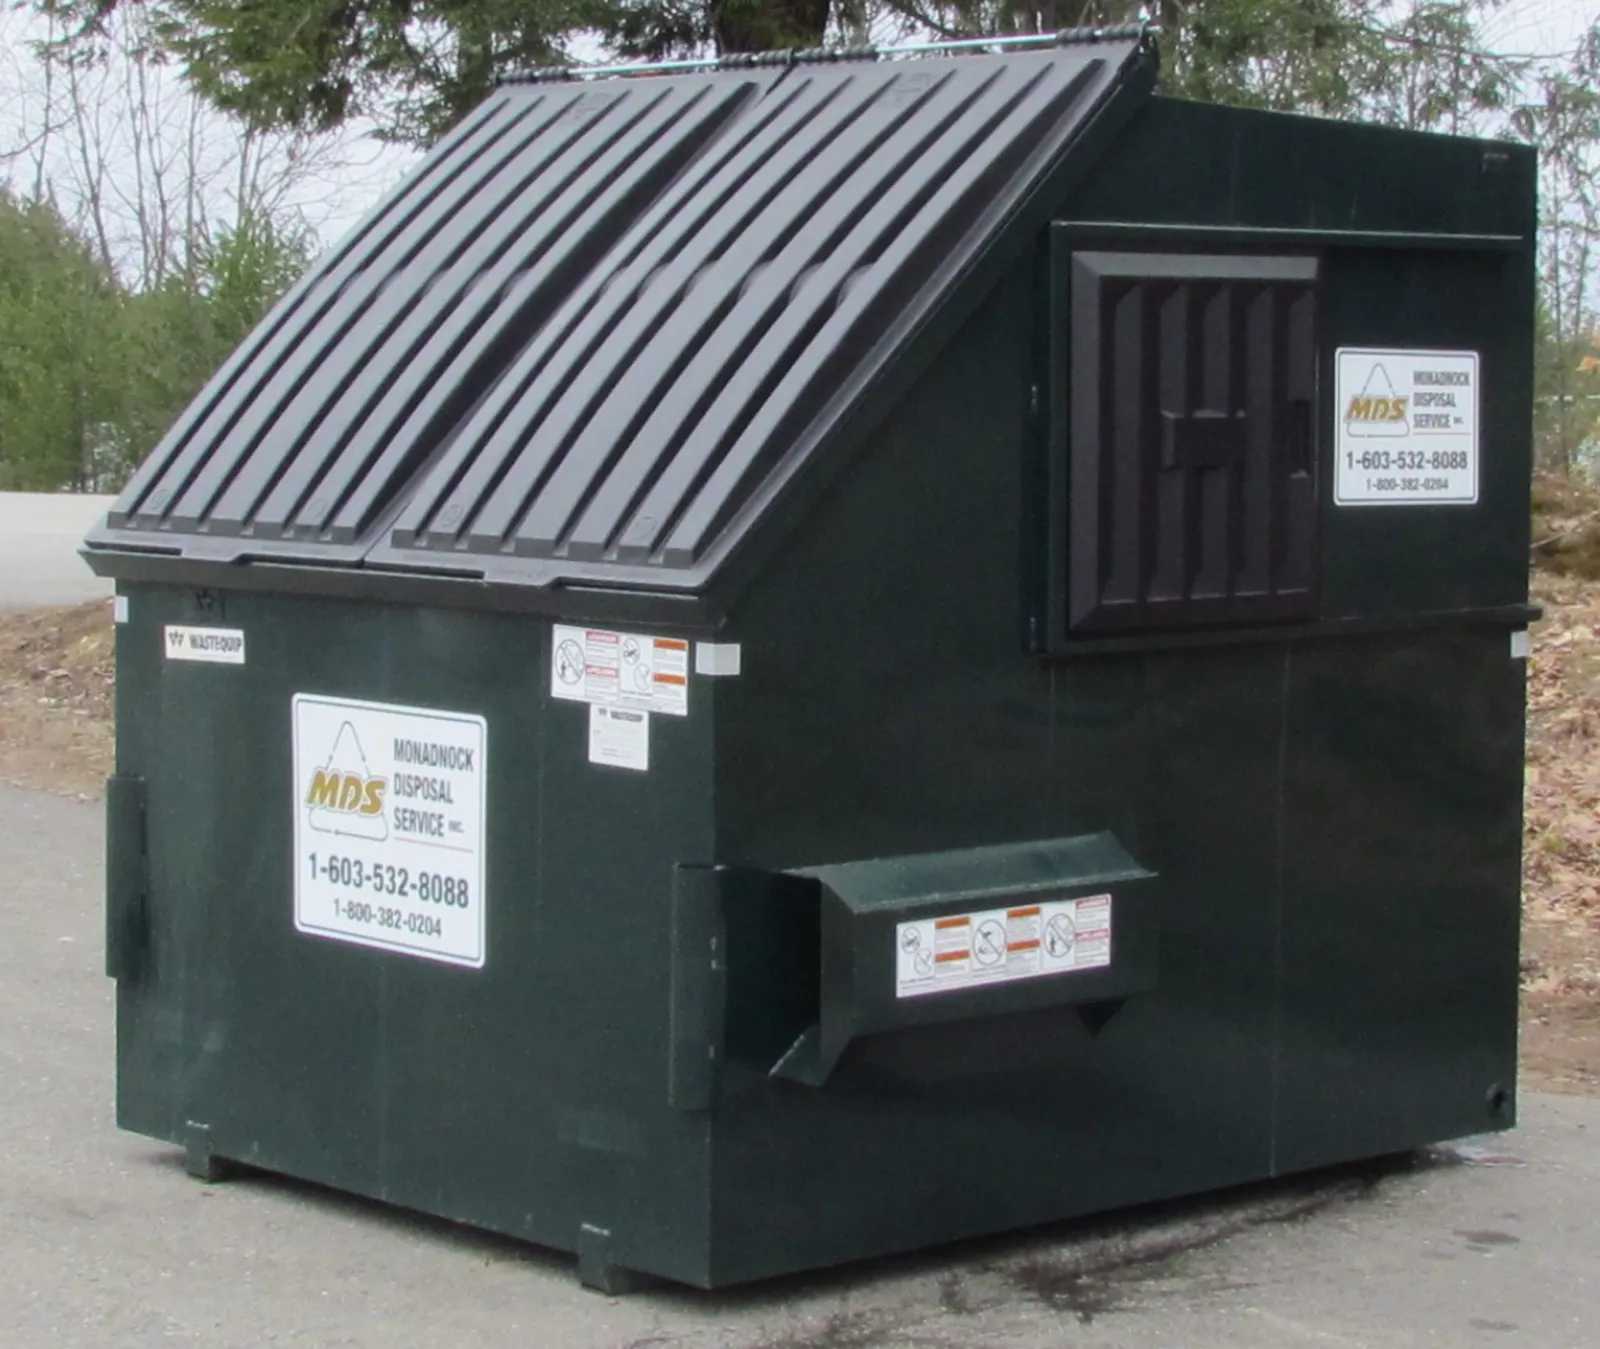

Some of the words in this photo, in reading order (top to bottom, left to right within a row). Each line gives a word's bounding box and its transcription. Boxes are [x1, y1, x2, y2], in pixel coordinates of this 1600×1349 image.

[1413, 371, 1470, 386] MONADNOCK
[1346, 397, 1408, 421] MDS
[1413, 392, 1456, 408] DISPOSAL
[1413, 413, 1451, 429] SERVICE
[1347, 451, 1468, 470] 1-603-532-8088
[1366, 478, 1449, 491] 1-800-382-0204
[189, 633, 242, 653] WASTEQUIP
[393, 738, 475, 772] MONADNOCK
[307, 770, 387, 816] MDS
[393, 773, 454, 804] DISPOSAL
[393, 807, 445, 837] SERVICE
[308, 852, 469, 908] 1-603-532-8088
[333, 898, 442, 937] 1-800-382-0204
